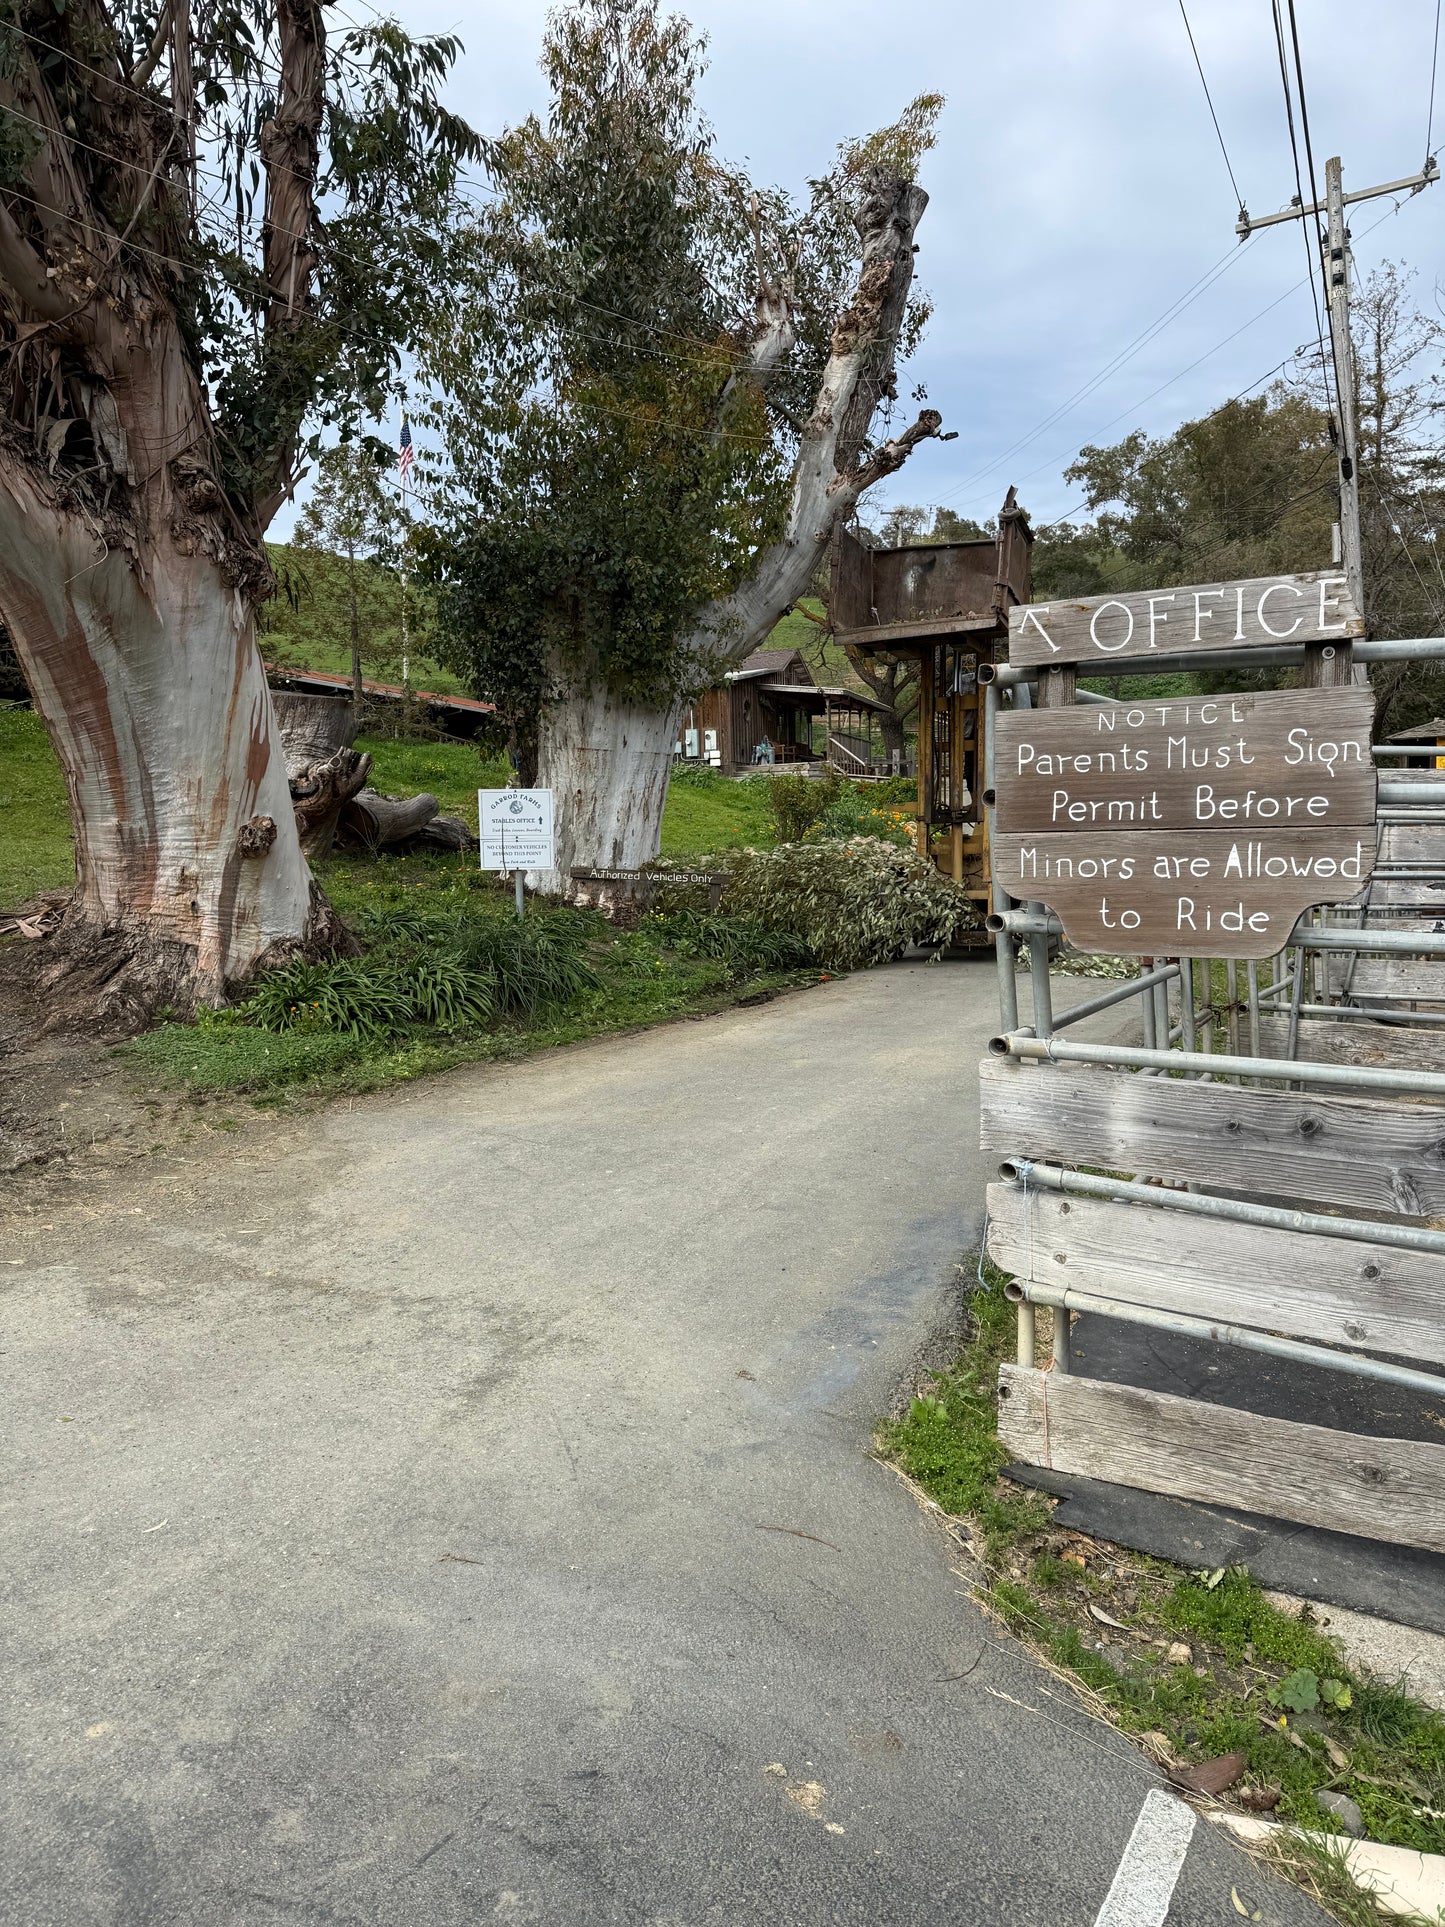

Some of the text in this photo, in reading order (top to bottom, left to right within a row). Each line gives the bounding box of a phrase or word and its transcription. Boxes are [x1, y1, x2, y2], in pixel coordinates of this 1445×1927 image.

[1090, 577, 1348, 651] OFFICE
[1098, 702, 1245, 731] NOTICE
[1018, 728, 1363, 777] Parents Must Sign
[490, 793, 518, 810] GARROD
[1052, 785, 1330, 822] Permit Before
[646, 871, 689, 883] Vehicles
[690, 873, 713, 884] Only
[1019, 840, 1362, 879] Minors are Allowed
[1099, 897, 1270, 932] to Ride
